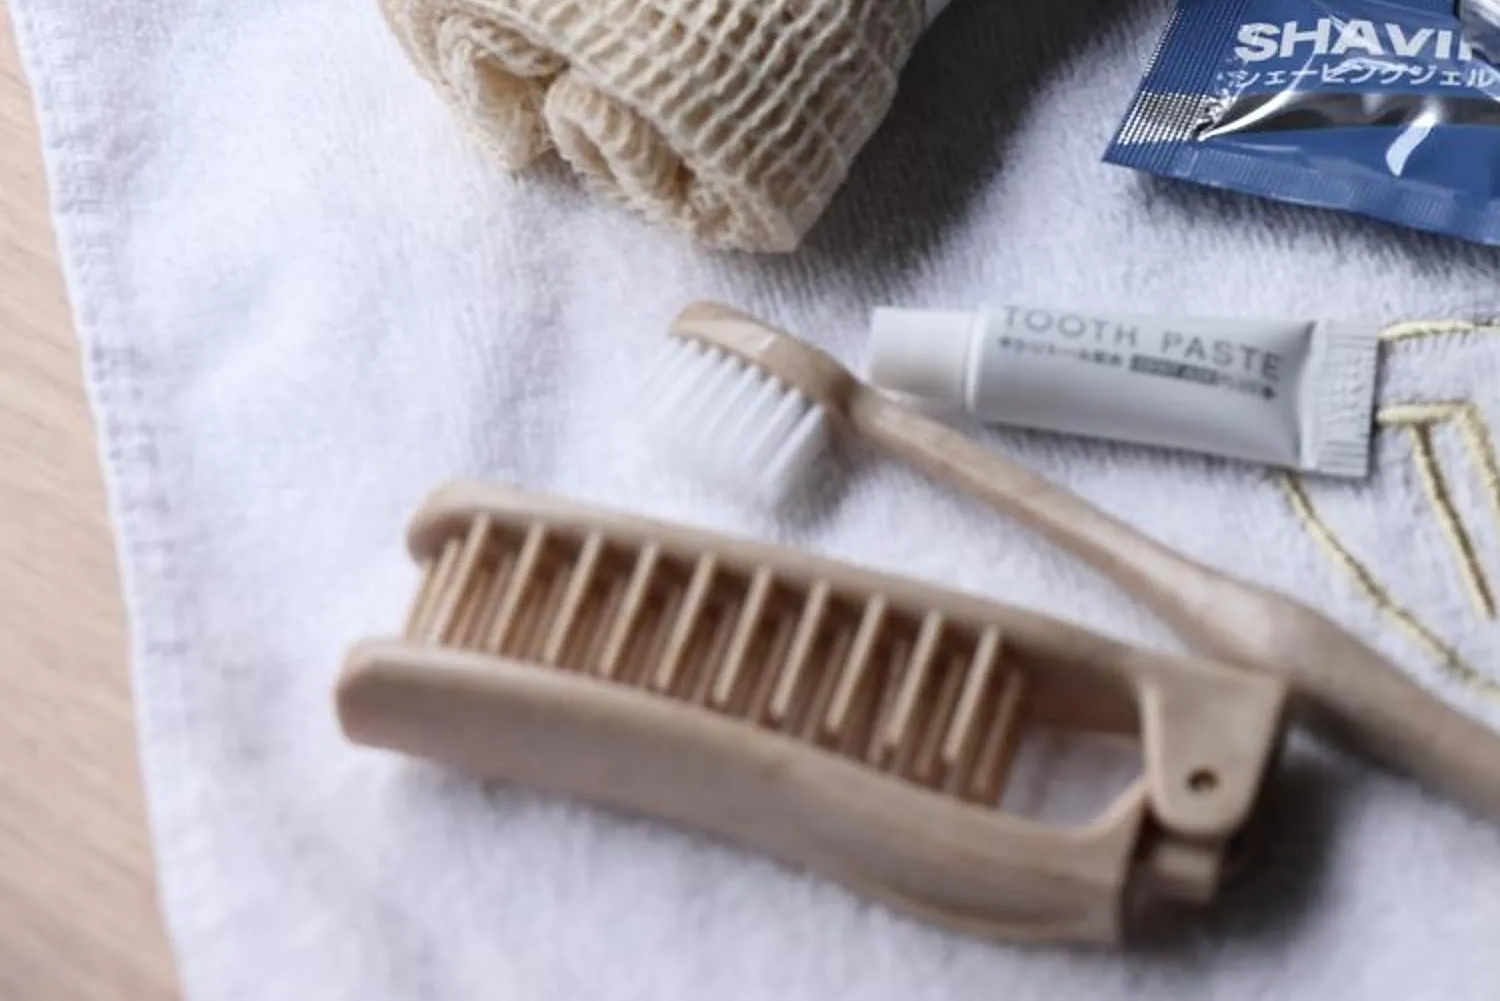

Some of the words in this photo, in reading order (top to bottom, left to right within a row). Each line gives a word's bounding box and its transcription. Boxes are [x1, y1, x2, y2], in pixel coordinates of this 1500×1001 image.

[1234, 17, 1474, 63] SHAVI
[1002, 303, 1138, 348] TOOTH
[1160, 330, 1283, 384] PASTE
